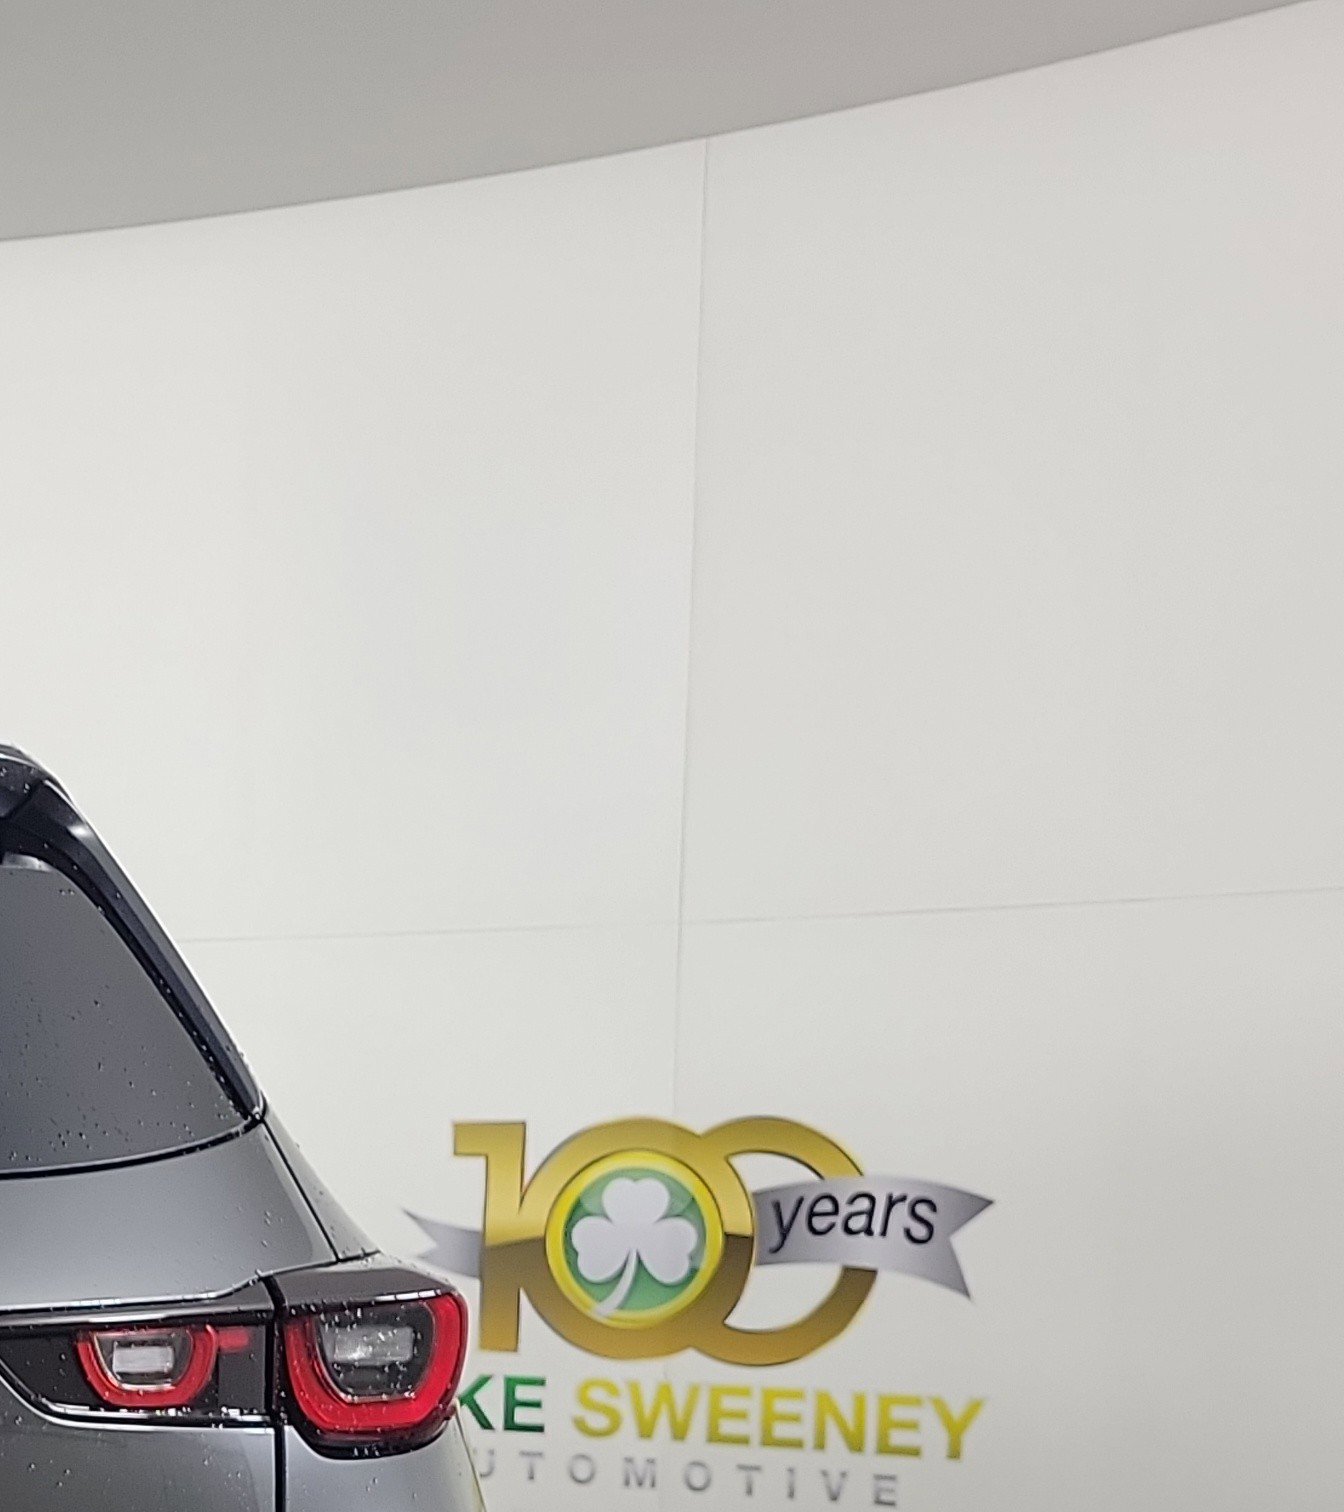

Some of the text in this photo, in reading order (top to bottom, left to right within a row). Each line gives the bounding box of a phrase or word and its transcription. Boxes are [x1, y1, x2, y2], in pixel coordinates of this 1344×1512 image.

[452, 1115, 940, 1367] 100 years
[458, 1374, 987, 1461] KE SWEENEY
[472, 1447, 898, 1508] UTOMOTIVE
